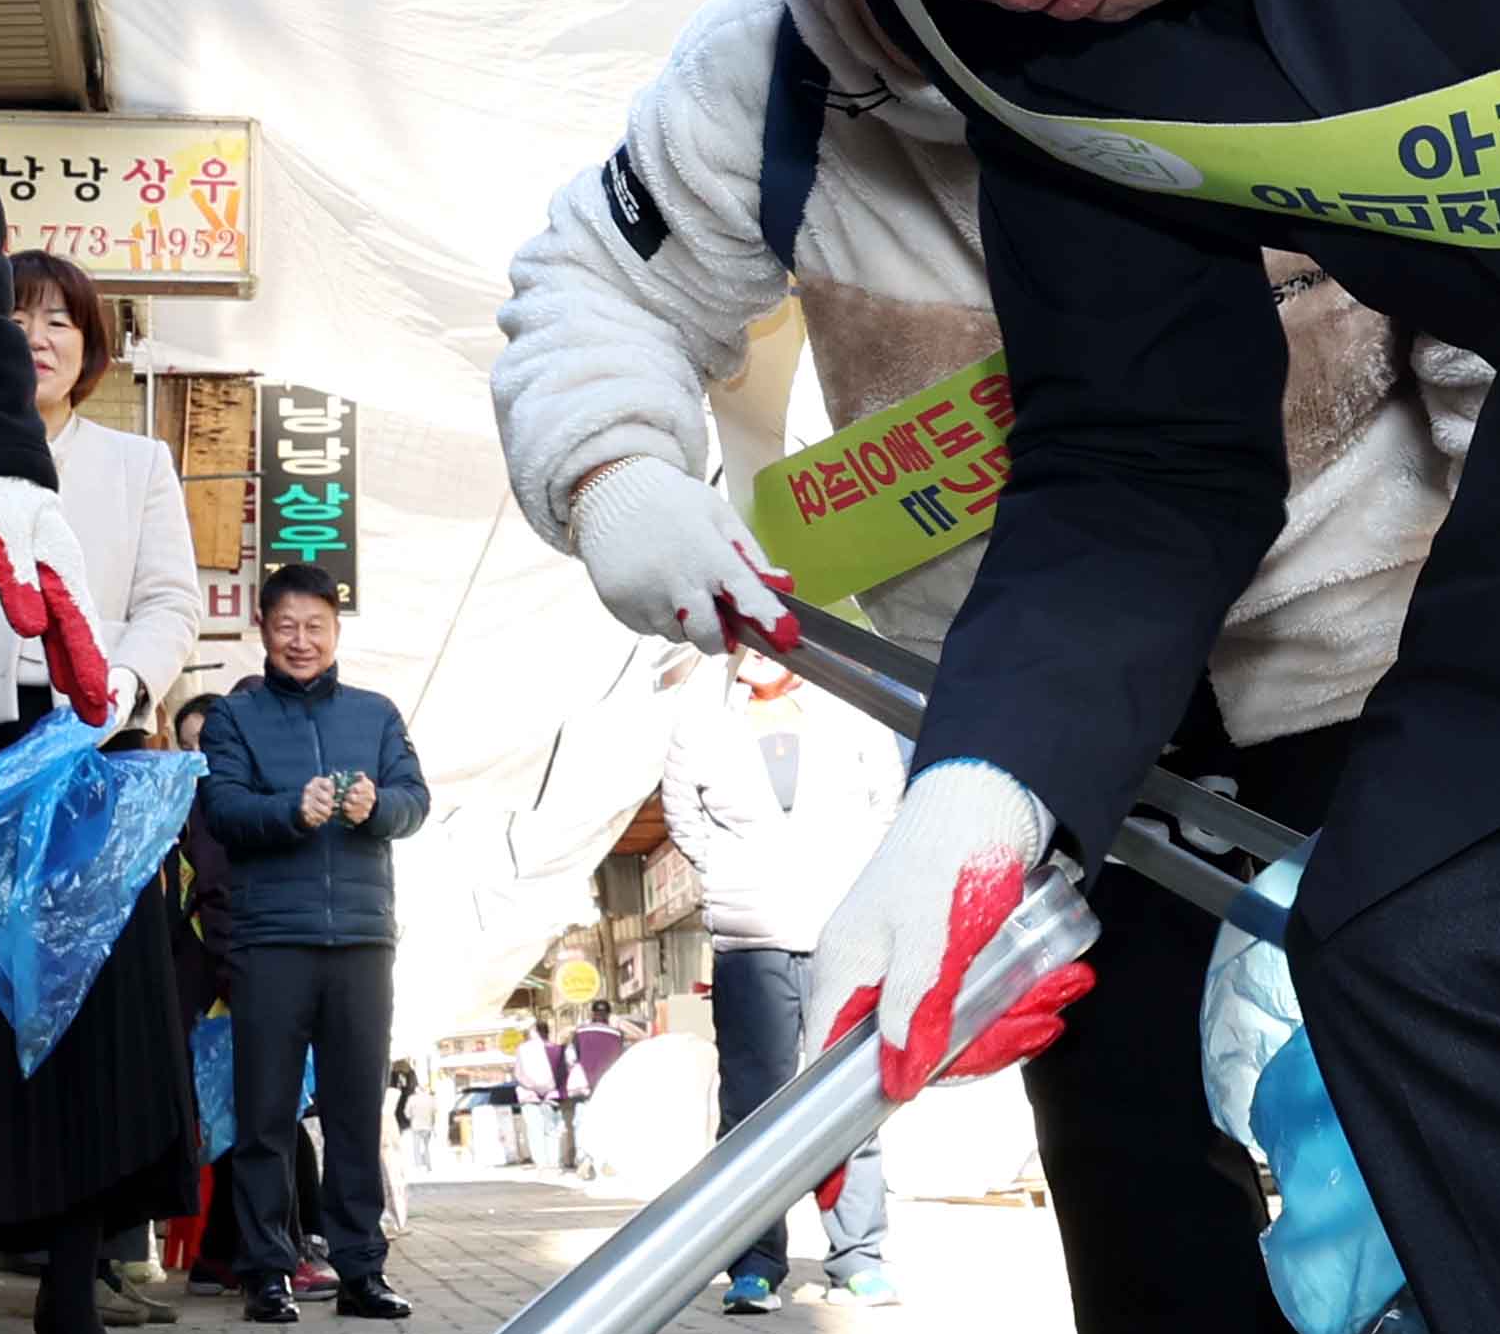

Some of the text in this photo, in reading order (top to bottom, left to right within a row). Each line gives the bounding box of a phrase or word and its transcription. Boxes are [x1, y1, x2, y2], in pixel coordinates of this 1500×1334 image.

[40, 223, 238, 259] 773-1952
[787, 400, 985, 525] 내놓으세요
[899, 444, 1014, 537] 기는
